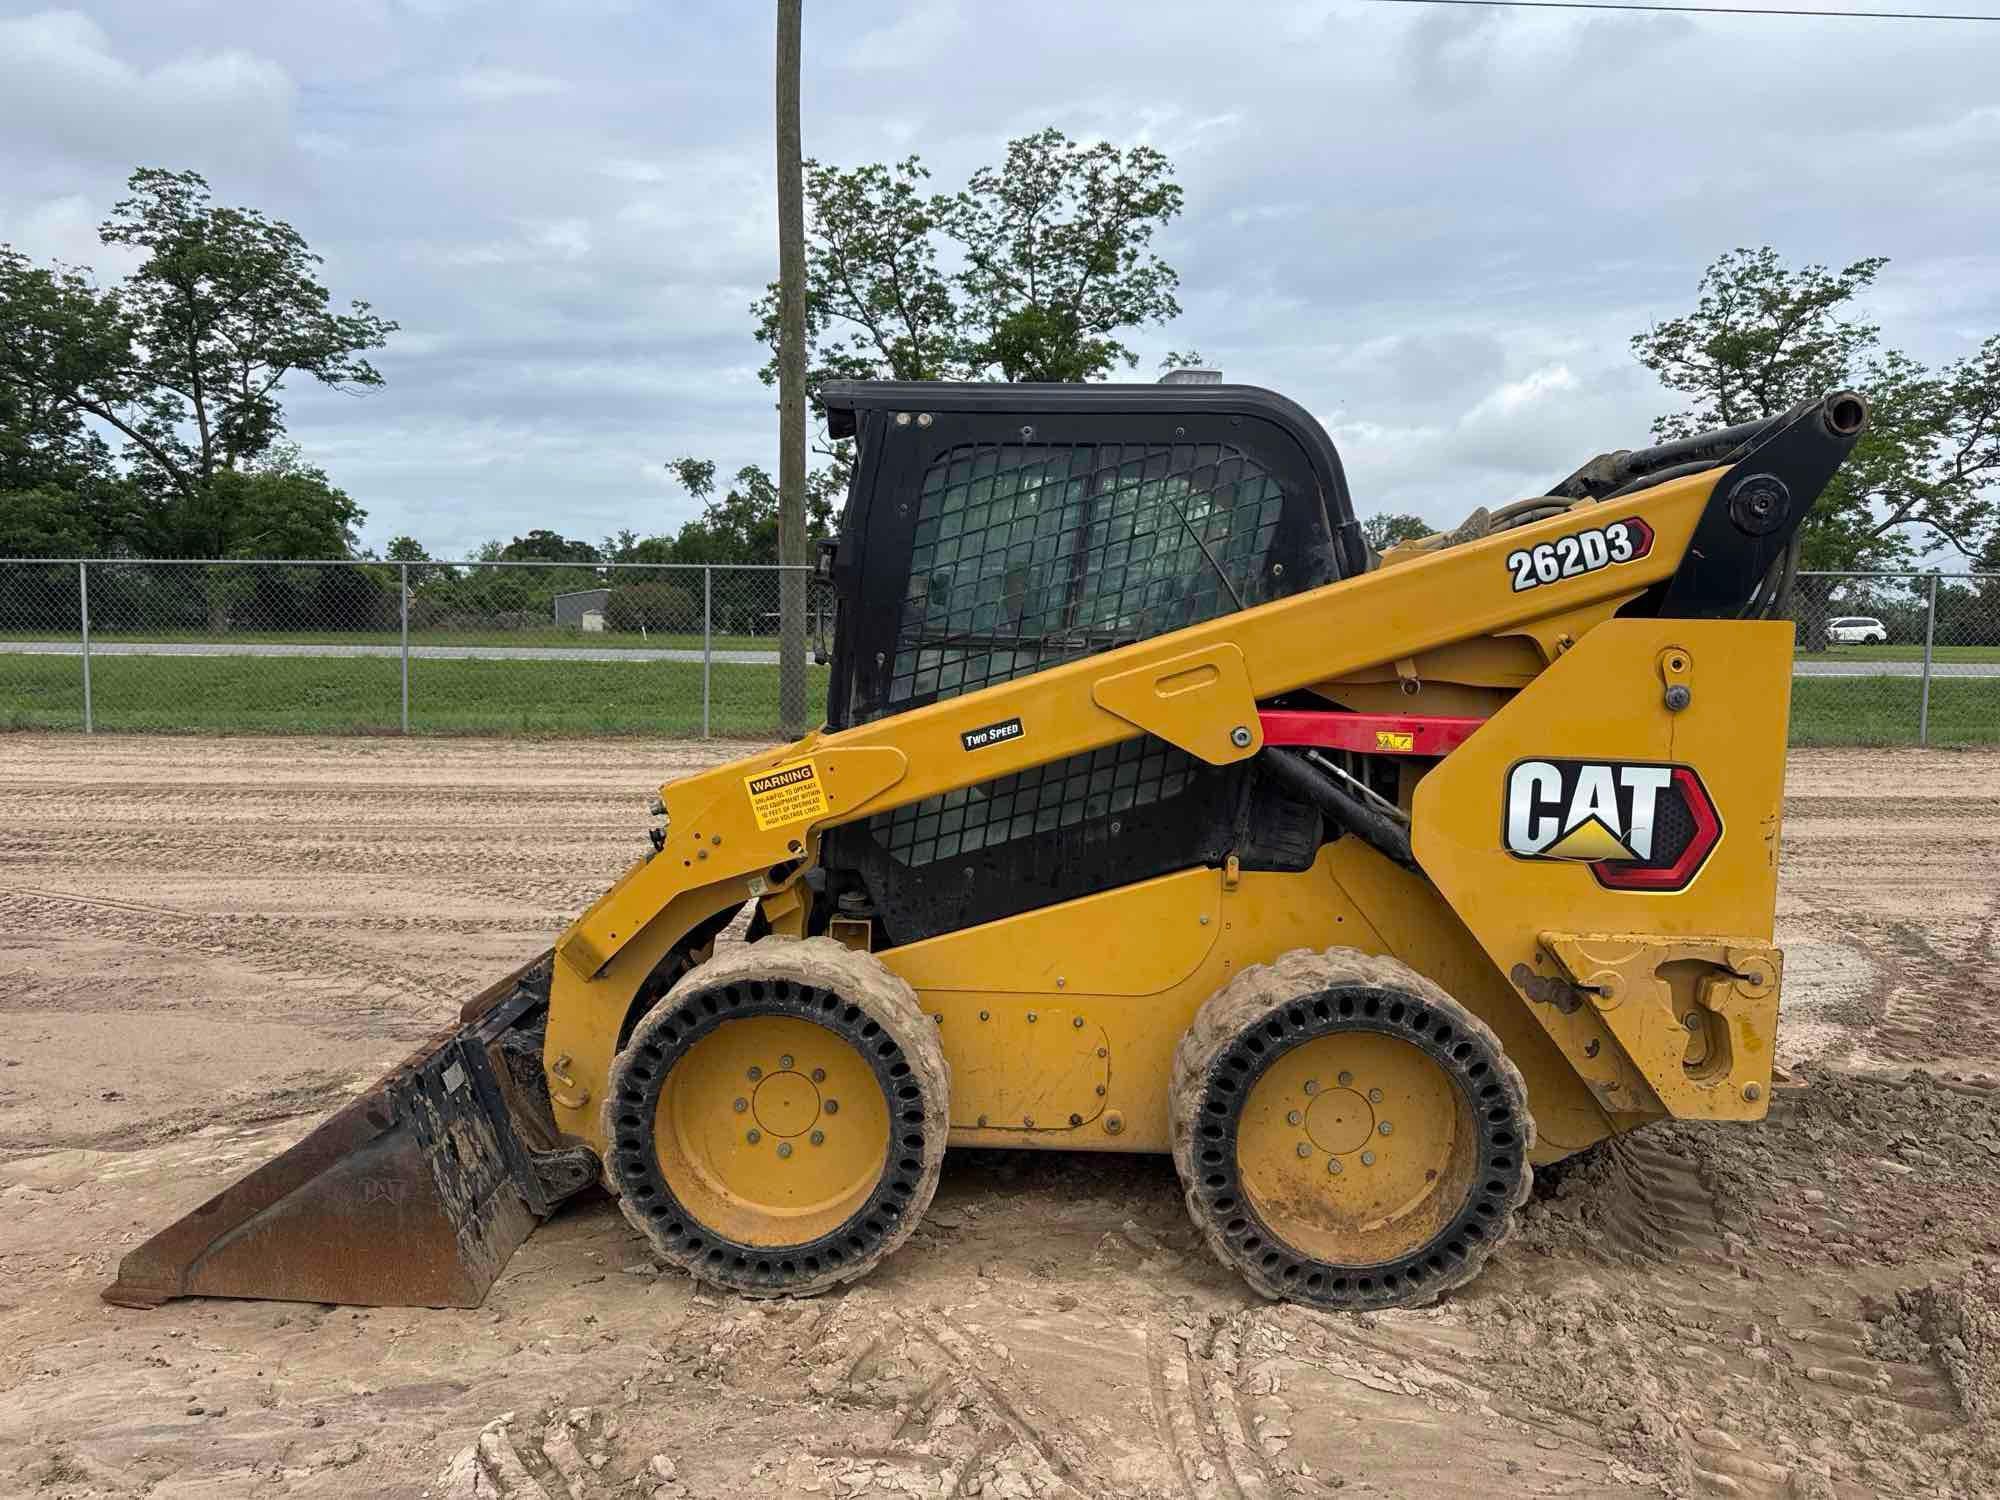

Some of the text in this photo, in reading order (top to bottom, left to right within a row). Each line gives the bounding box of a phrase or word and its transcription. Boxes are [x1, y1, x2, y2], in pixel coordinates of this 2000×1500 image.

[1508, 523, 1633, 591] 262D3
[752, 767, 811, 792] WARNING
[793, 783, 816, 793] OPERATE
[756, 804, 768, 812] THIS
[780, 810, 802, 821] VOLTAGE
[1508, 761, 1672, 860] CAT
